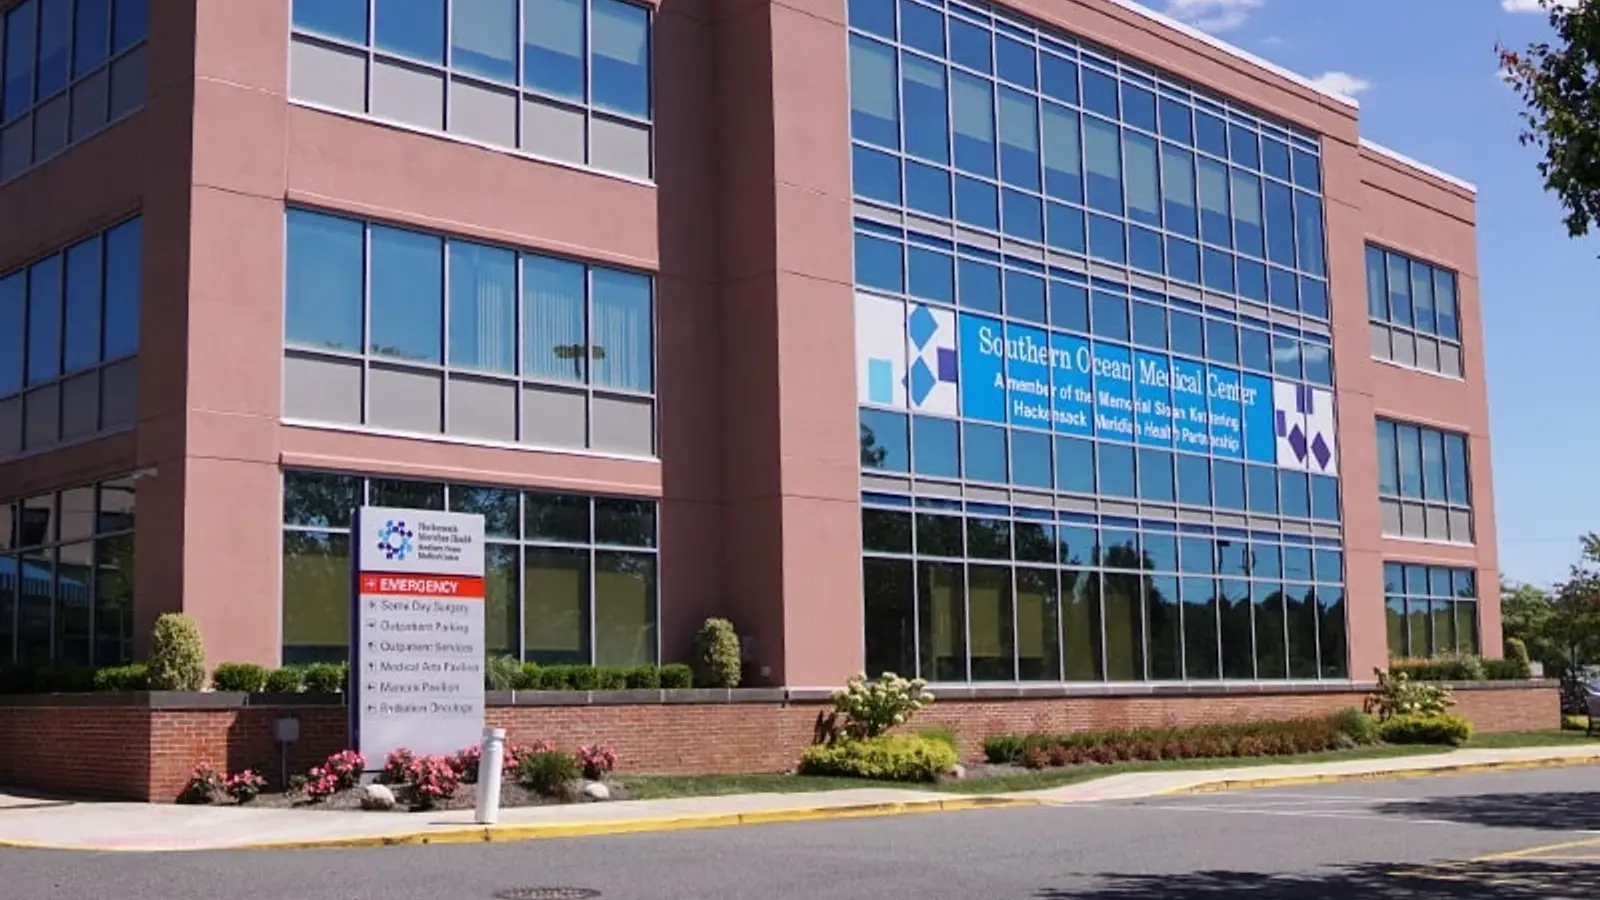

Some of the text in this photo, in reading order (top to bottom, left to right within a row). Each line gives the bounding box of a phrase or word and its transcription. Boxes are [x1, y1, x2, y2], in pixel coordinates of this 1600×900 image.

[978, 325, 1257, 406] Southern Ocean Medical Center
[1005, 377, 1057, 399] member
[1059, 384, 1072, 401] of
[1074, 387, 1093, 404] the
[1098, 390, 1152, 414] Memorial
[1189, 406, 1240, 433] Ketering
[1013, 399, 1241, 453] Hackensack Meridian Health Partnership
[380, 578, 459, 594] EMERGENCY
[412, 600, 431, 614] Day
[433, 601, 469, 615] Surgery
[435, 622, 470, 635] Parking
[435, 642, 473, 653] Services
[380, 661, 420, 672] Medical
[444, 662, 479, 672] Pavilion
